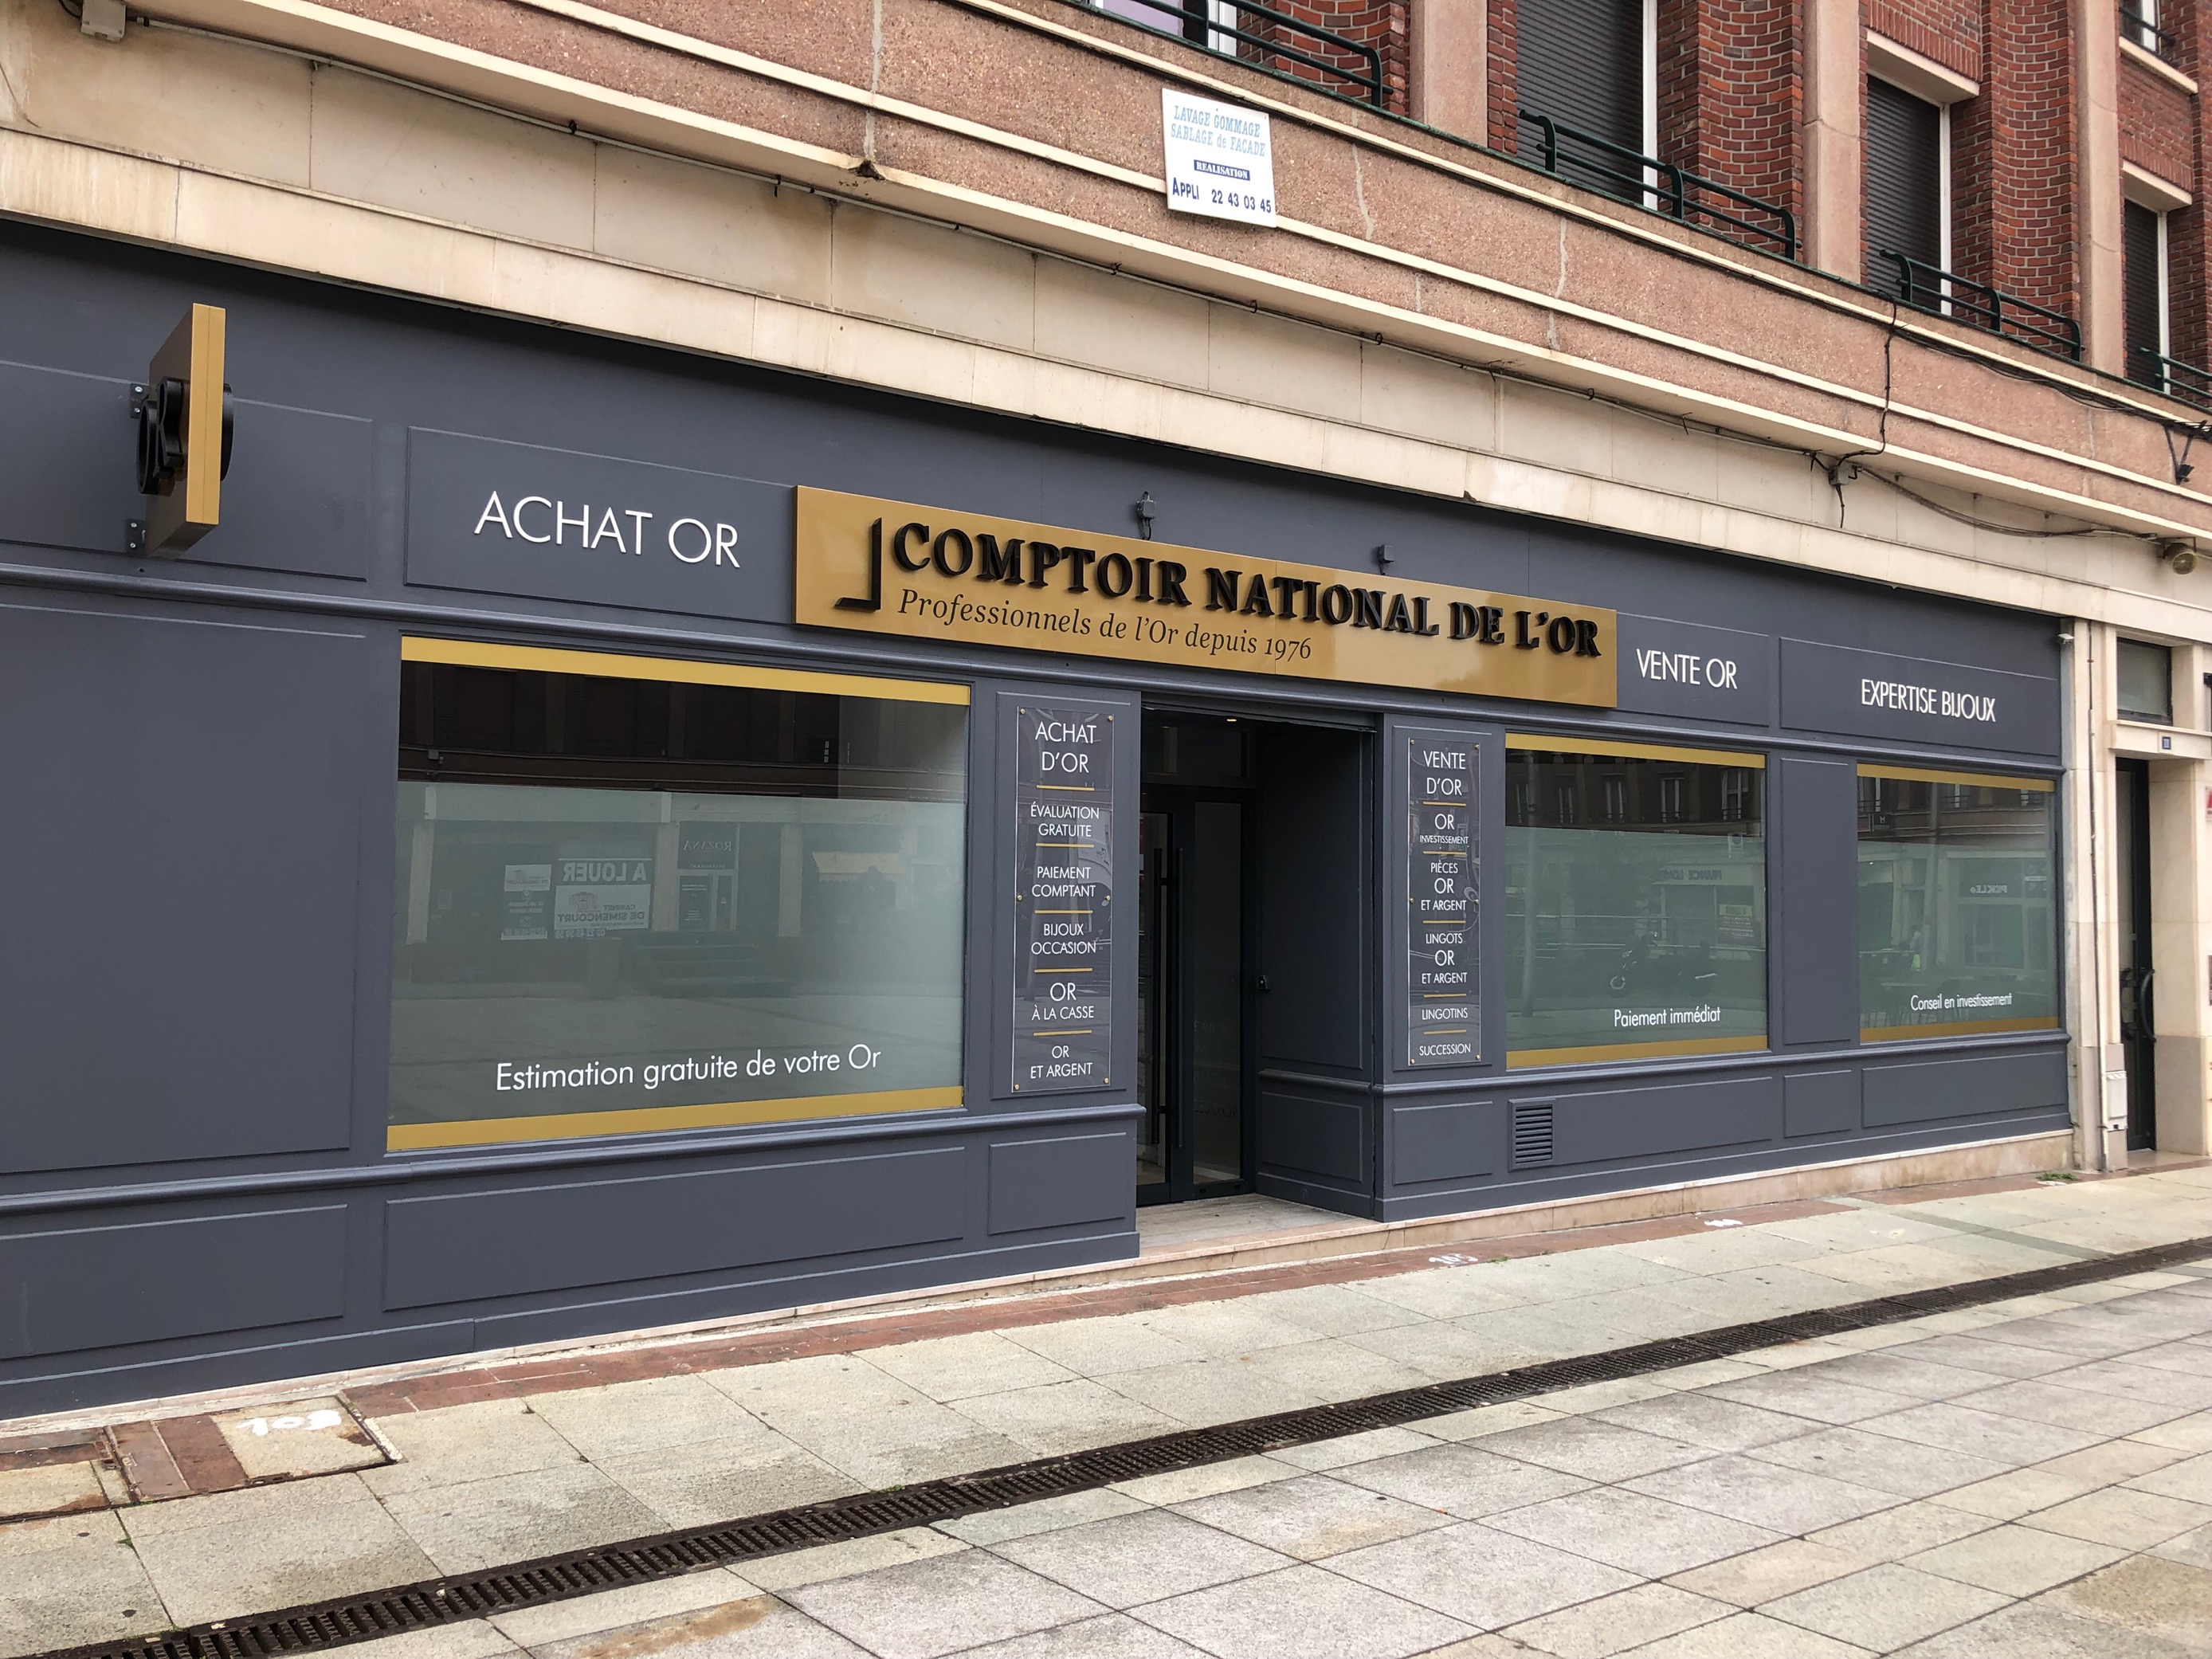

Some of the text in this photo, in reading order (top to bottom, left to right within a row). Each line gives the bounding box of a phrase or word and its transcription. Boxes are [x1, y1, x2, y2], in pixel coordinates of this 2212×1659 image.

[1174, 105, 1260, 137] LAVAGE GOMMAGE
[1171, 124, 1265, 157] SABLAGE de FACADE
[1196, 161, 1249, 179] REALISATION
[1173, 177, 1271, 213] APPLI 22 43 03 45
[474, 491, 739, 567] ACHAT OR
[894, 523, 1602, 657] COMPTOIR NATIONAL DE L'OR
[898, 588, 1312, 661] Professionnels de l'Or depuis 1976
[1637, 649, 1737, 688] VENTE OR
[1862, 679, 1995, 722] EXPERTISE BIJOUX
[1035, 722, 1096, 743] ACHAT
[1042, 751, 1088, 773] D'OR
[1423, 751, 1466, 769] VENTE
[1427, 777, 1462, 795] D'OR
[1030, 802, 1099, 819] ÉVALUATION
[1435, 814, 1454, 830] OR
[1038, 824, 1092, 837] GRATUITE
[1420, 835, 1469, 844] INVESTISSEMENT
[1037, 866, 1091, 879] PAIEMENT
[1430, 860, 1458, 873] PIÈCES
[1032, 884, 1096, 897] COMPTANT
[1434, 877, 1454, 893] OR
[1422, 900, 1466, 911] ET ARGENT
[1044, 924, 1084, 936] BIJOUX
[1426, 933, 1463, 944] LINGOTS
[1031, 942, 1096, 955] OCCASION
[1435, 950, 1455, 966] OR
[1422, 972, 1467, 984] ET ARGENT
[1050, 982, 1077, 1002] OR
[1911, 993, 2012, 1011] Conseil en investissement
[1032, 1005, 1094, 1021] À LA CASSE
[1422, 1008, 1468, 1020] LINGOTINS
[1615, 1005, 1720, 1026] Paiement immédiat
[1052, 1045, 1069, 1059] OR
[1419, 1044, 1471, 1056] SUCCESSION
[497, 1045, 880, 1090] Estimation gratuite de votre Or
[1030, 1063, 1092, 1078] ET ARGENT
